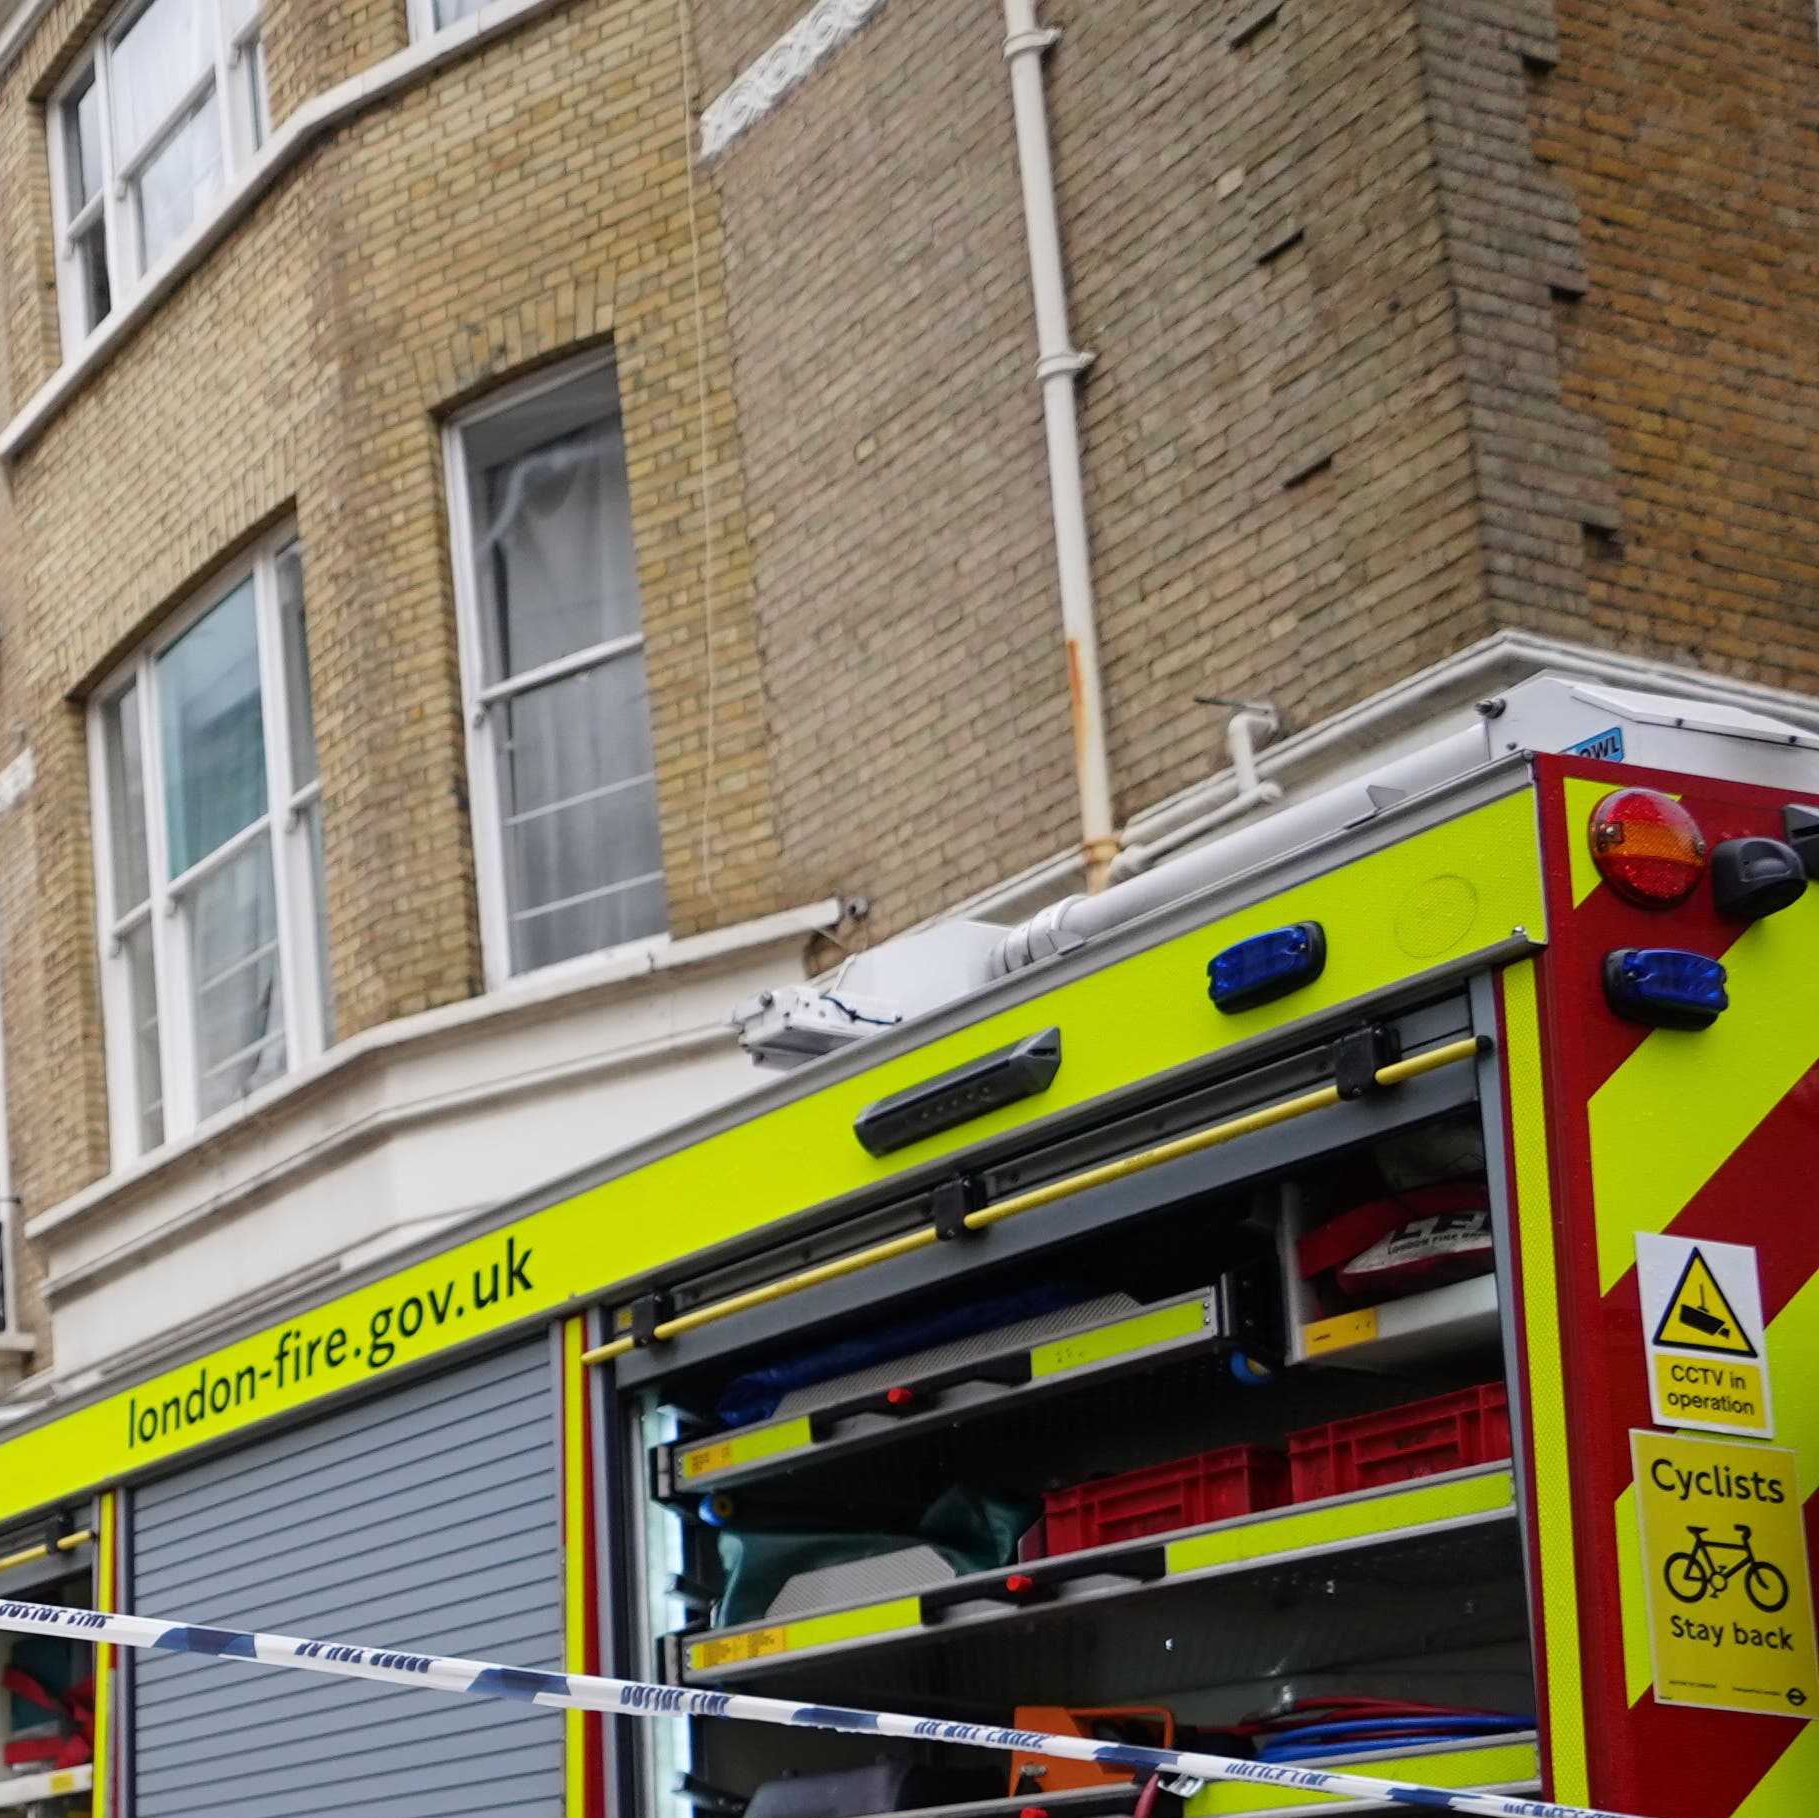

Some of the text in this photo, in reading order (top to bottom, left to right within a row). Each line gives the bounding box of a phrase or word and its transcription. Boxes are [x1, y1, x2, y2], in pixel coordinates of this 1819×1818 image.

[129, 1236, 535, 1449] london-fire.gov.uk
[1671, 1365, 1746, 1390] CCTV in
[1667, 1391, 1755, 1416] operation
[1650, 1457, 1785, 1505] Cyclists
[1670, 1615, 1795, 1652] Stay back
